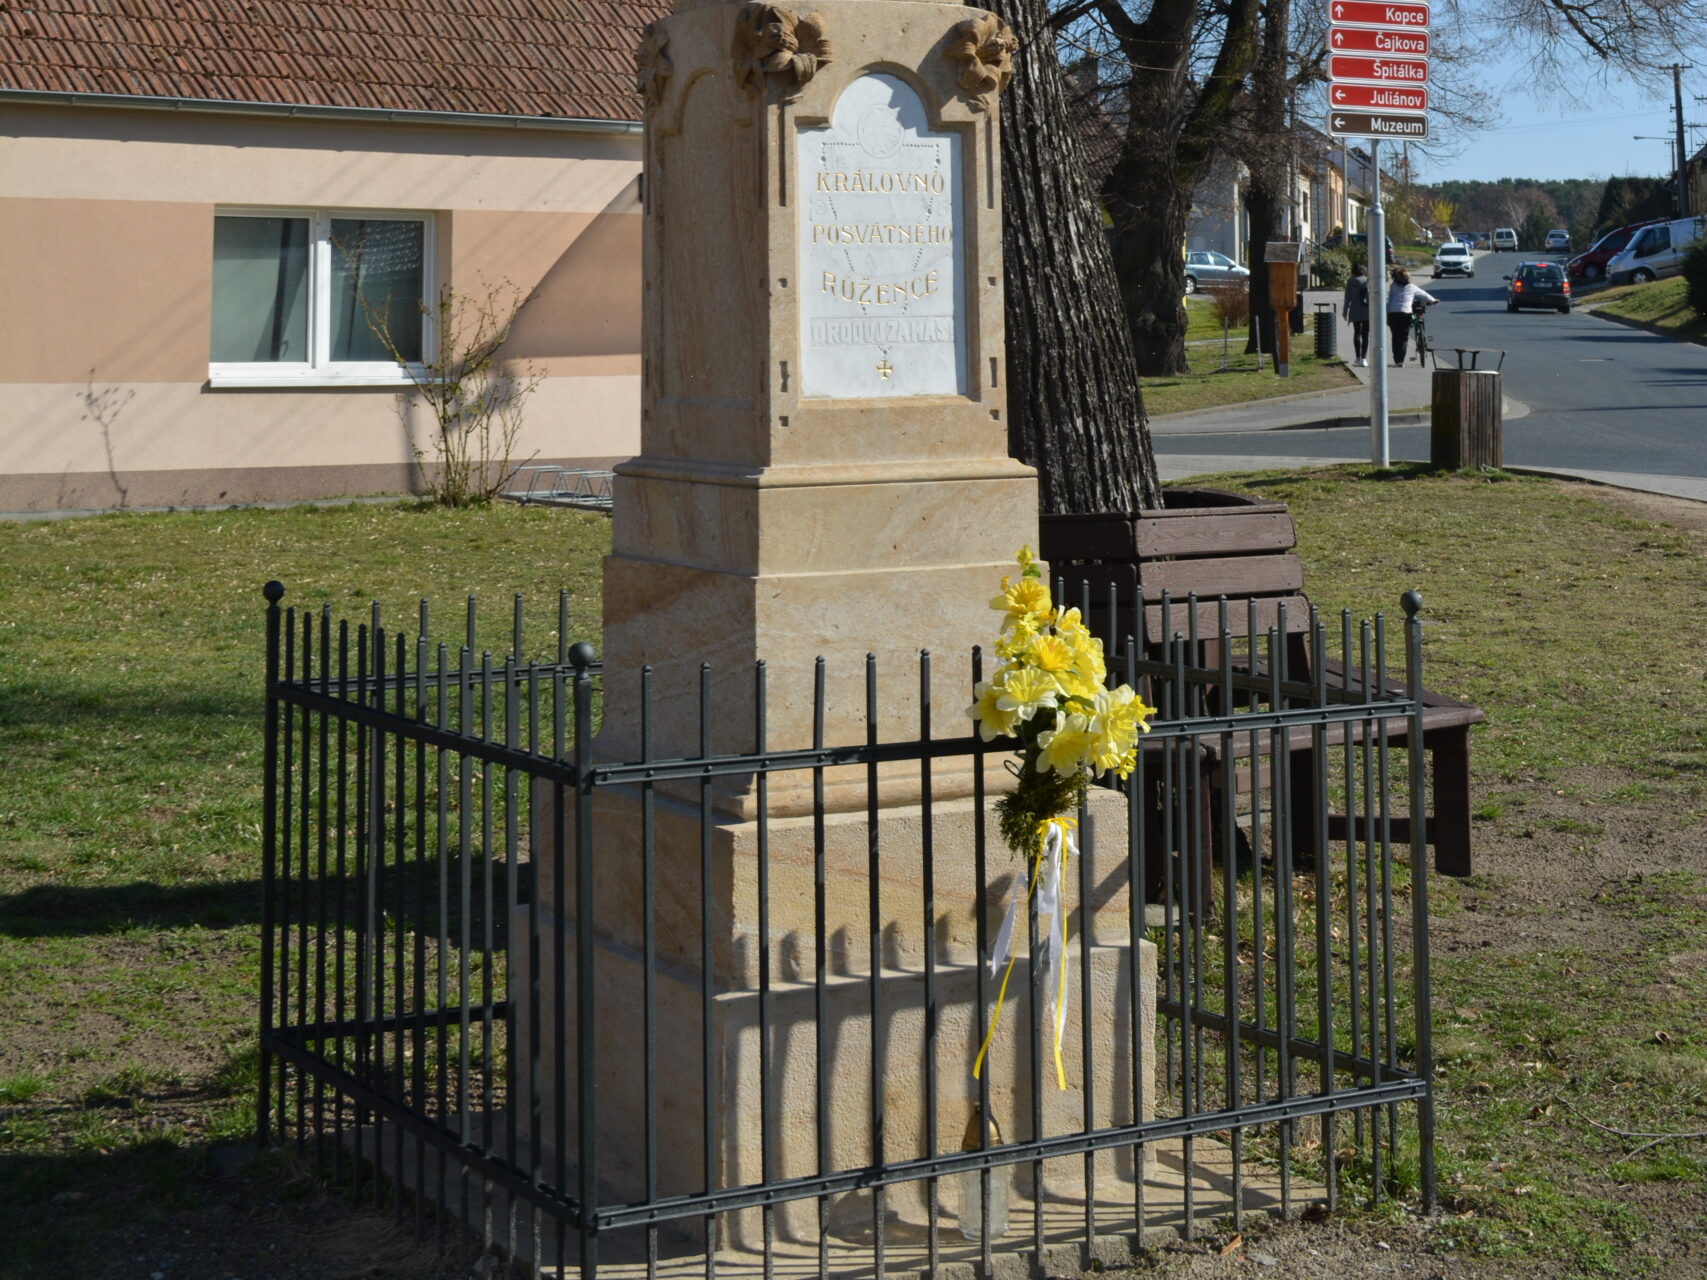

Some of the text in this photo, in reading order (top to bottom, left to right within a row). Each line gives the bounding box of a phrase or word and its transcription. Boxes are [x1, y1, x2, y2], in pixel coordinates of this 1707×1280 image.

[1385, 7, 1424, 26] Kopce
[1375, 30, 1425, 52] Čajkova
[1373, 58, 1424, 80] Špitálka
[1370, 90, 1422, 107] Juliánov
[1370, 117, 1424, 134] Muzeum
[815, 169, 945, 194] KRÁLOVNO
[811, 222, 953, 246] POSVÁTNÉHO
[821, 270, 940, 306] RŮŽENCE
